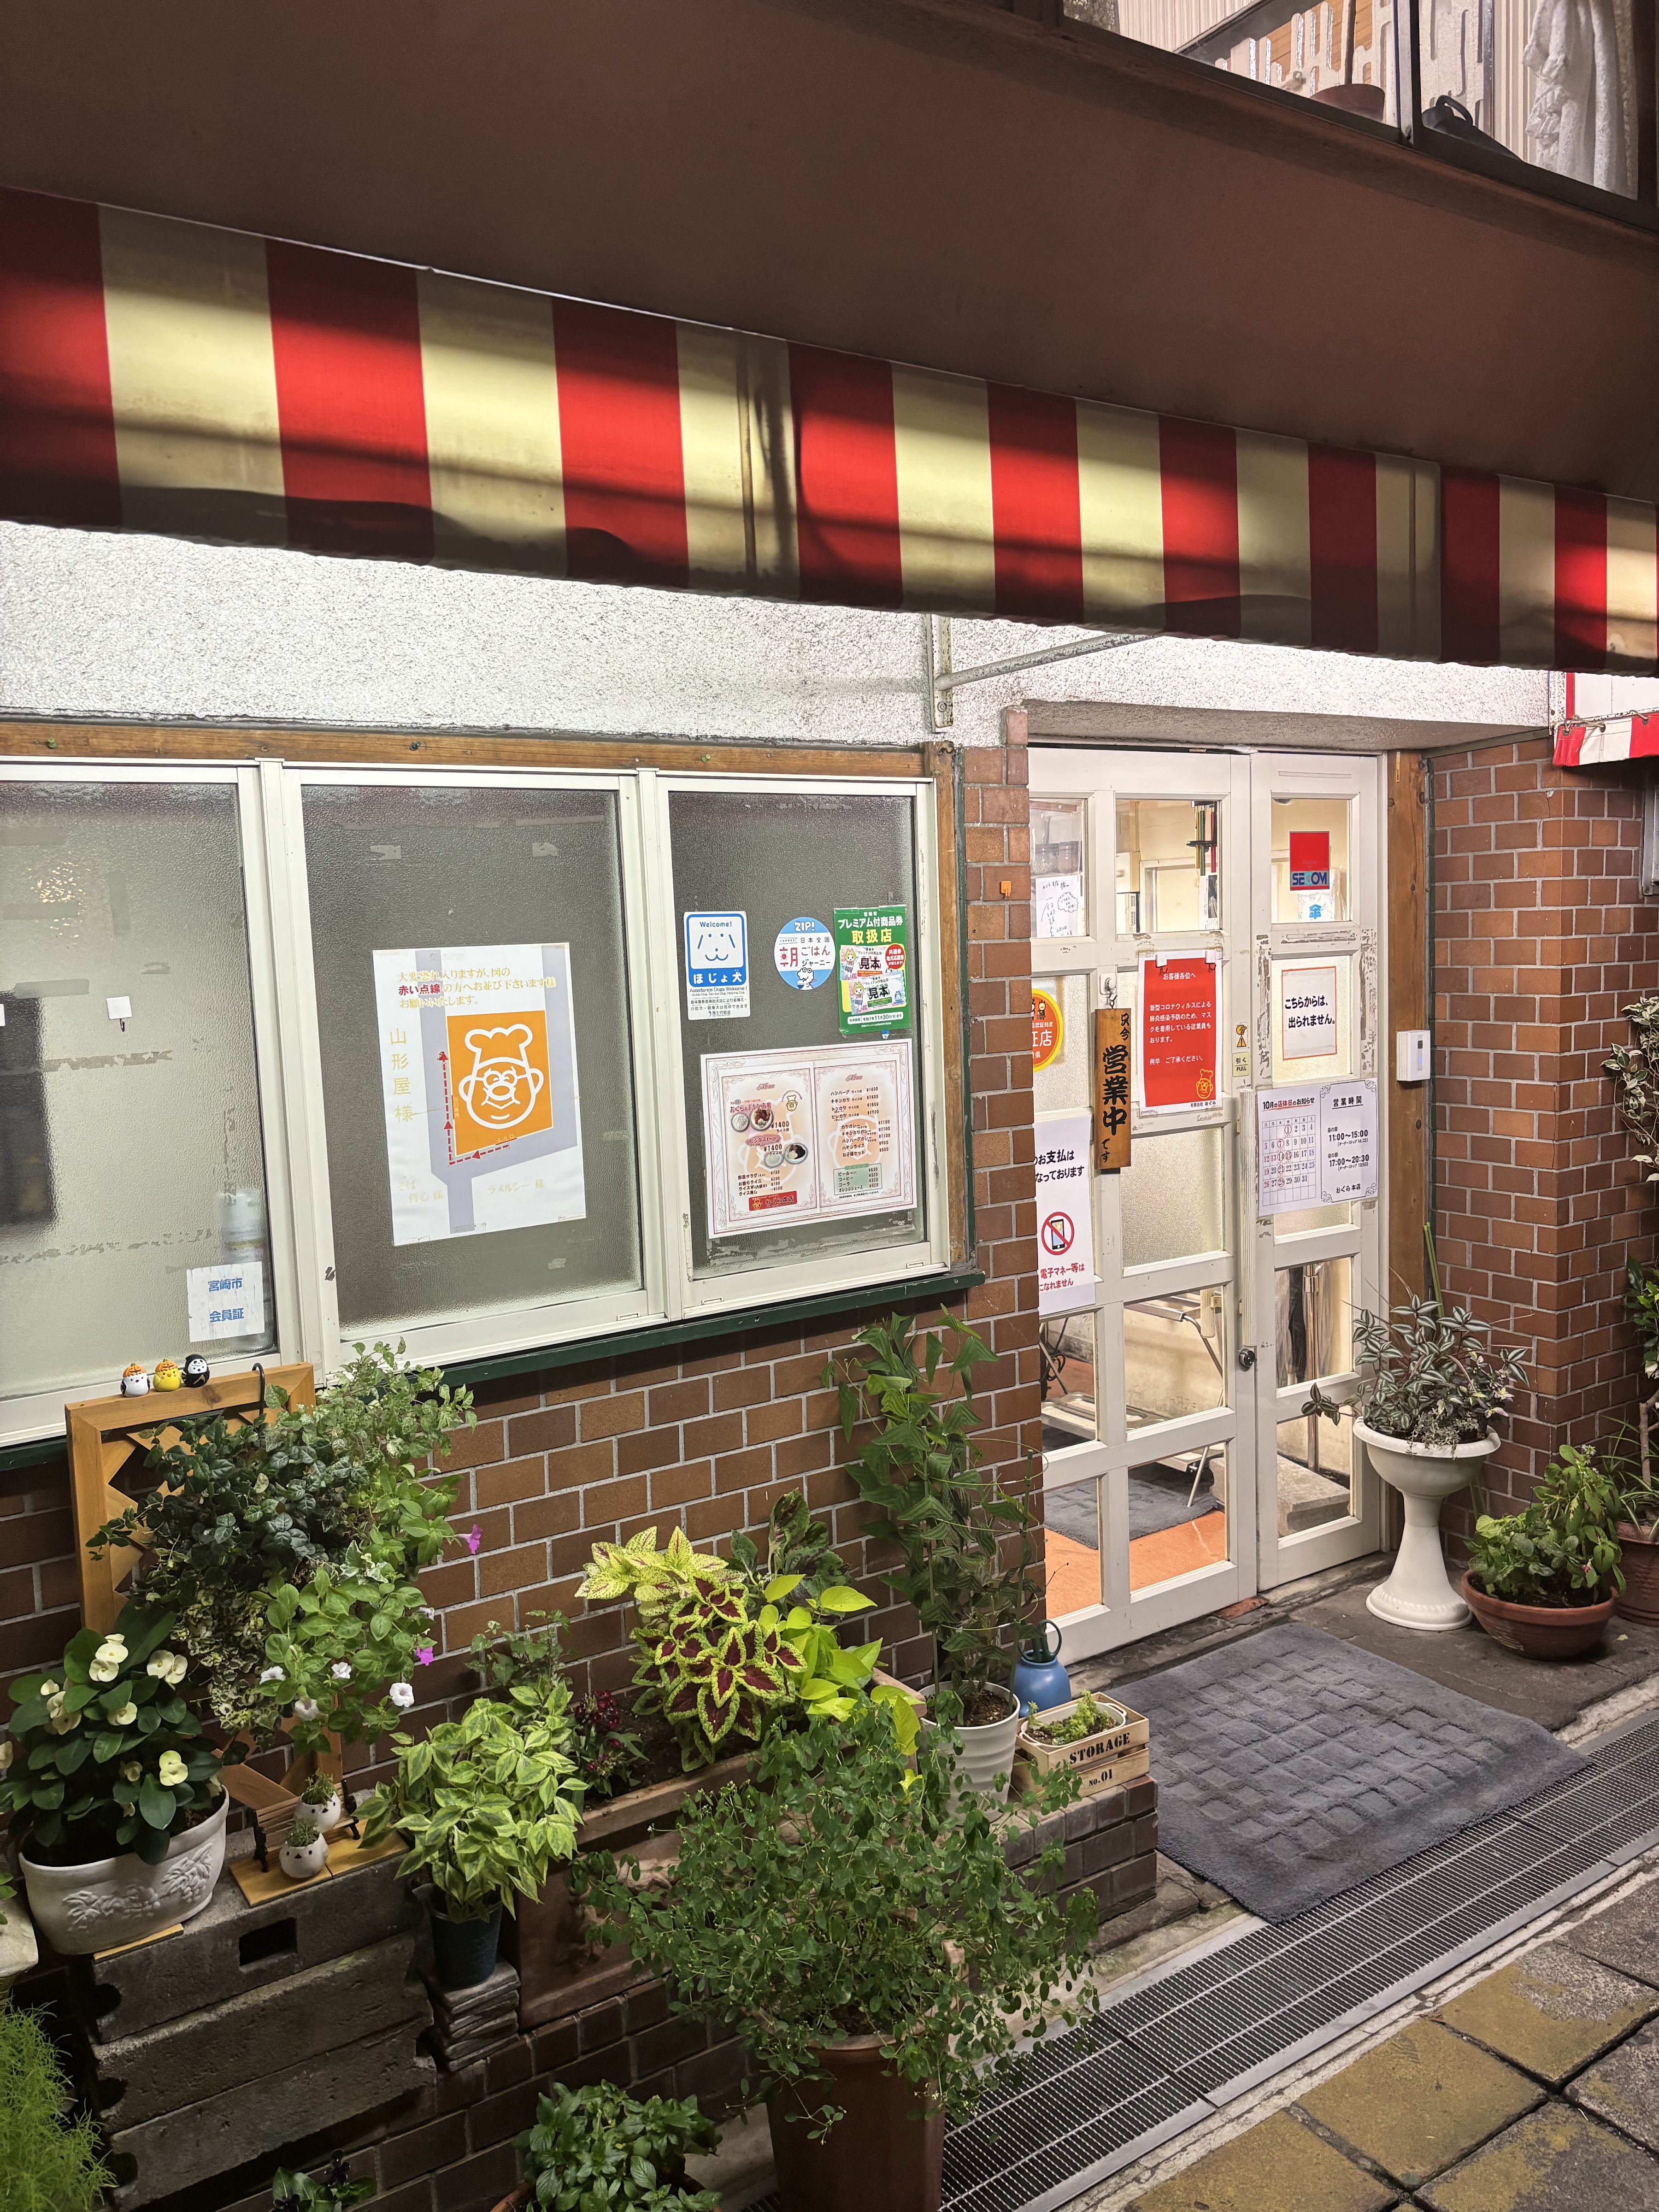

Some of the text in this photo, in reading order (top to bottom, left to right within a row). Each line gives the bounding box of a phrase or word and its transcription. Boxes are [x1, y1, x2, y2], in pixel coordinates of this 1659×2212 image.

[1292, 872, 1327, 885] SECOM
[1309, 904, 1321, 919] 傘
[794, 921, 815, 932] ZIP!
[838, 916, 903, 929] プレミアム付商品券
[852, 928, 892, 945] 取扱店
[802, 946, 830, 956] ごはん
[860, 958, 880, 970] 見本
[399, 968, 510, 982] 大変恐れ入りますが、図の
[694, 971, 742, 984] ほじょ犬
[1163, 972, 1196, 980] お客様各位へ
[869, 987, 889, 1000] 見本
[1150, 1001, 1211, 1012] 新型コロナウィルスによる
[1285, 995, 1328, 1009] こちらからは、
[1149, 1012, 1211, 1022] 肺炎感染予防のため、マス
[1288, 1013, 1335, 1029] 出られません。
[1120, 1013, 1130, 1041] 只今
[1150, 1023, 1211, 1033] クを着用している従業員も
[1165, 1055, 1203, 1064] ご了承ください。
[390, 1028, 413, 1123] 山形屋様
[1102, 1044, 1129, 1136] 営業中
[1263, 1098, 1315, 1110] 10月の店休日のお知らせ
[1333, 1095, 1362, 1106] 営業時間
[1329, 1130, 1368, 1141] 11:00～15:00
[1330, 1154, 1369, 1167] 17:00～20:30
[1035, 1165, 1084, 1182] なっております
[1041, 1263, 1085, 1279] 電子マネー等は
[208, 1278, 242, 1292] 宮崎市
[209, 1308, 244, 1323] 会員証
[1070, 1732, 1130, 1765] STORAGE
